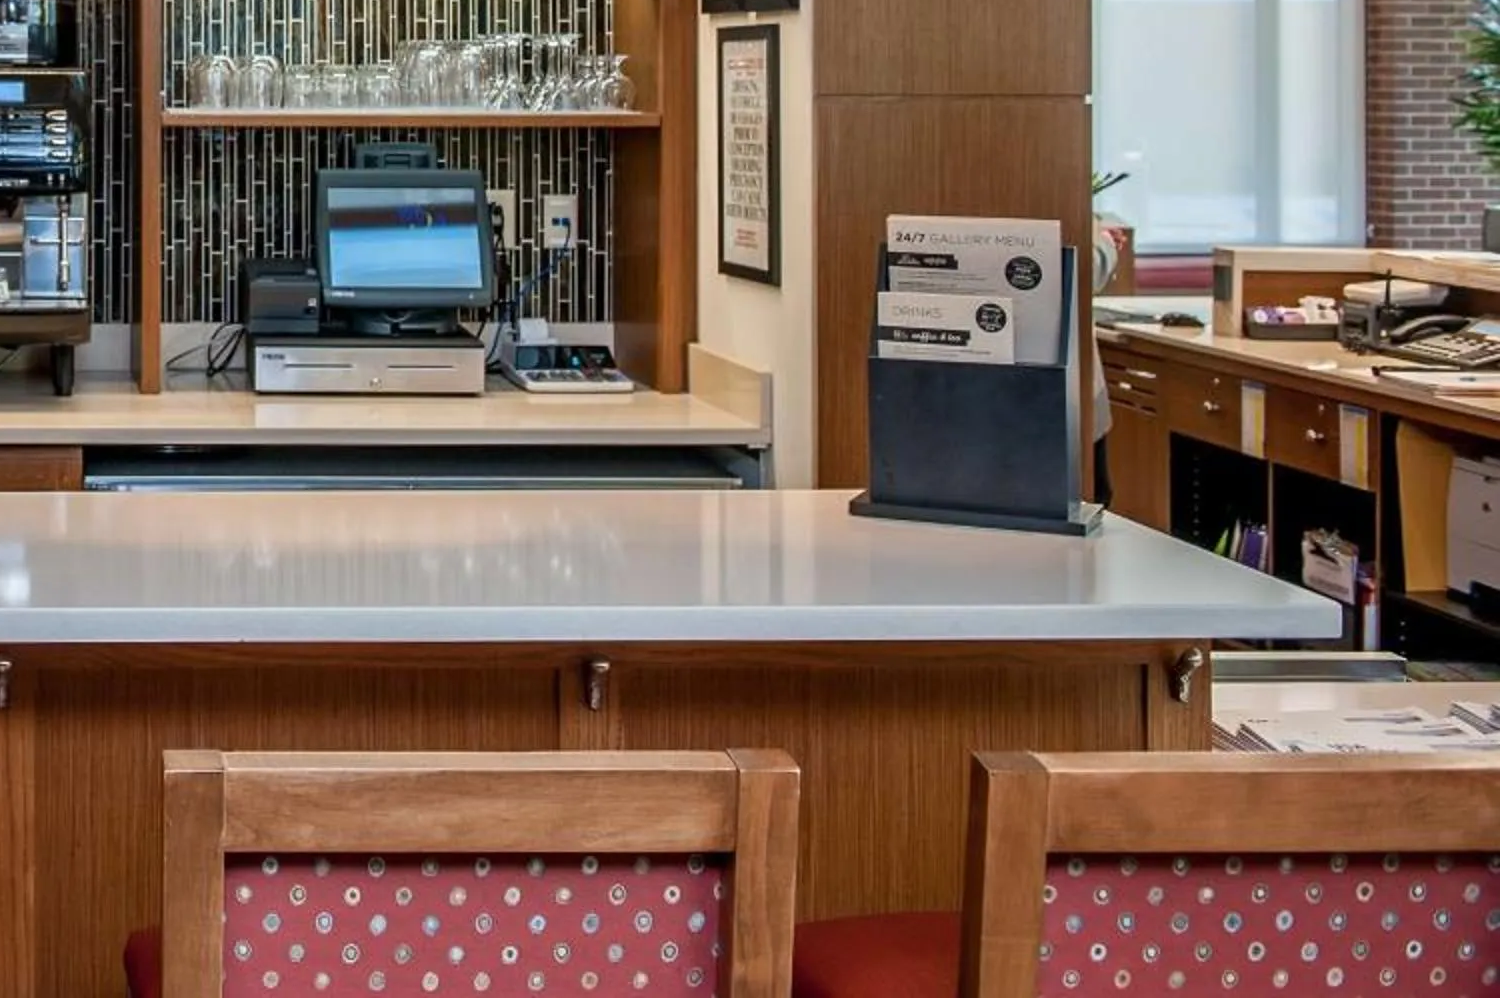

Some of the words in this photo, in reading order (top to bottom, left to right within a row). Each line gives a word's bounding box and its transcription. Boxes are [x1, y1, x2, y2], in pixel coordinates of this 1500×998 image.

[895, 231, 925, 244] 24/7
[929, 233, 991, 246] GALLERY
[995, 234, 1035, 248] MENU
[891, 304, 943, 319] DRINKS
